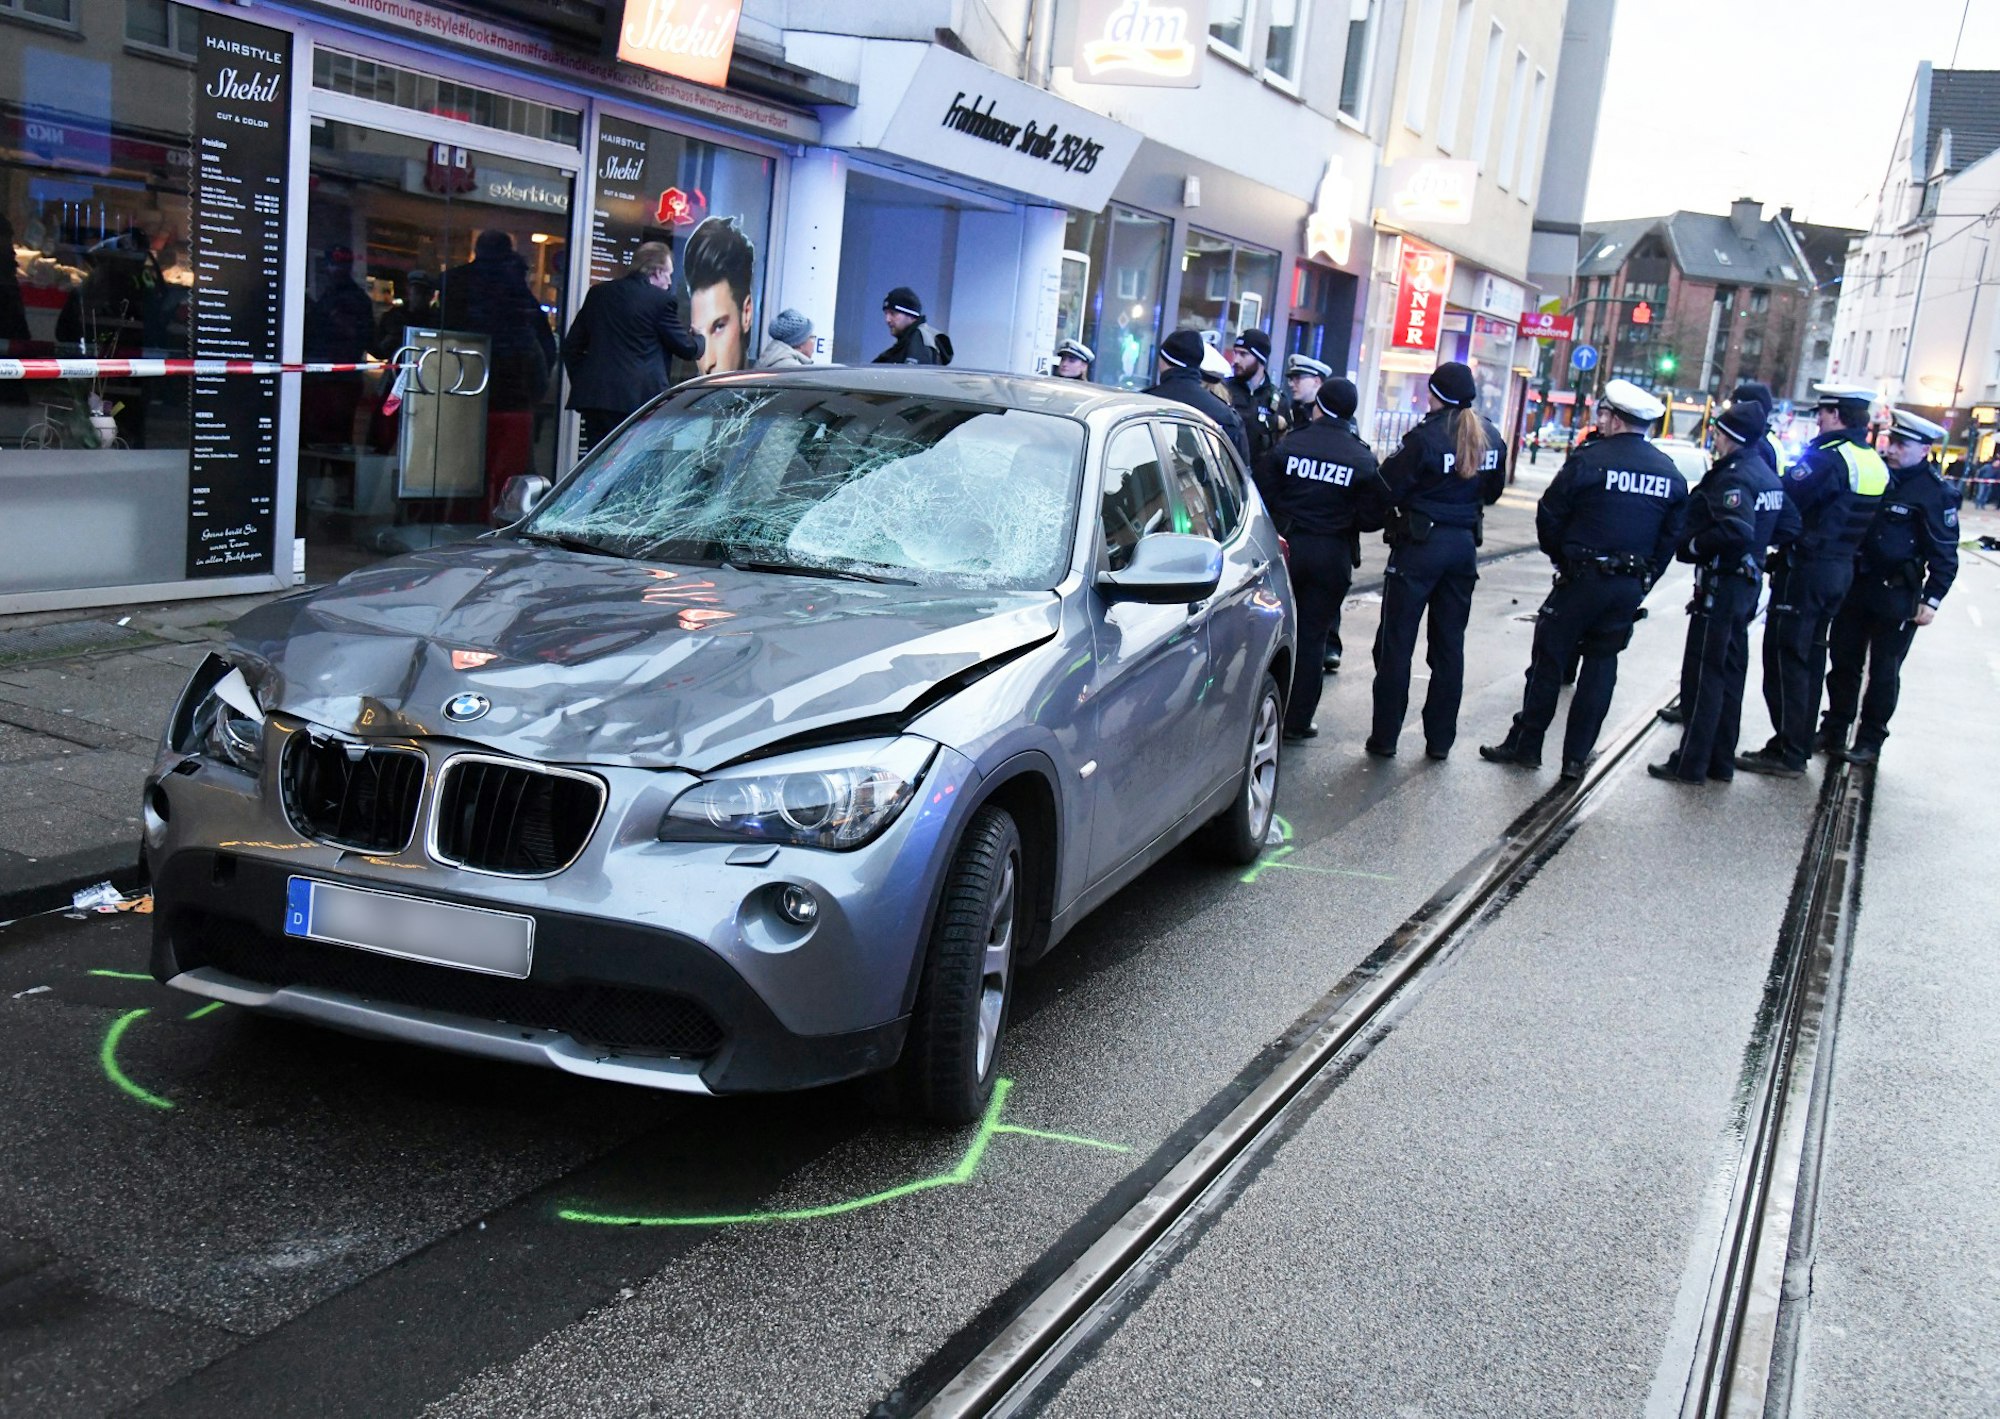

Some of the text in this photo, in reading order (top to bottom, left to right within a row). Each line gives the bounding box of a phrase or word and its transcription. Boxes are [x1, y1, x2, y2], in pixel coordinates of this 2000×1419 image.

[625, 0, 737, 58] Shekil
[1111, 0, 1180, 42] dm
[206, 36, 282, 64] HAIRSTYLE
[206, 67, 281, 102] Shekil
[216, 111, 269, 129] CUT & COLOR
[600, 133, 646, 152] HAIRSTYLE
[599, 155, 645, 181] Shekil
[1521, 326, 1570, 338] vodafone
[1285, 455, 1354, 487] POLIZEI
[1605, 469, 1671, 499] POLIZEI
[292, 911, 304, 925] D
